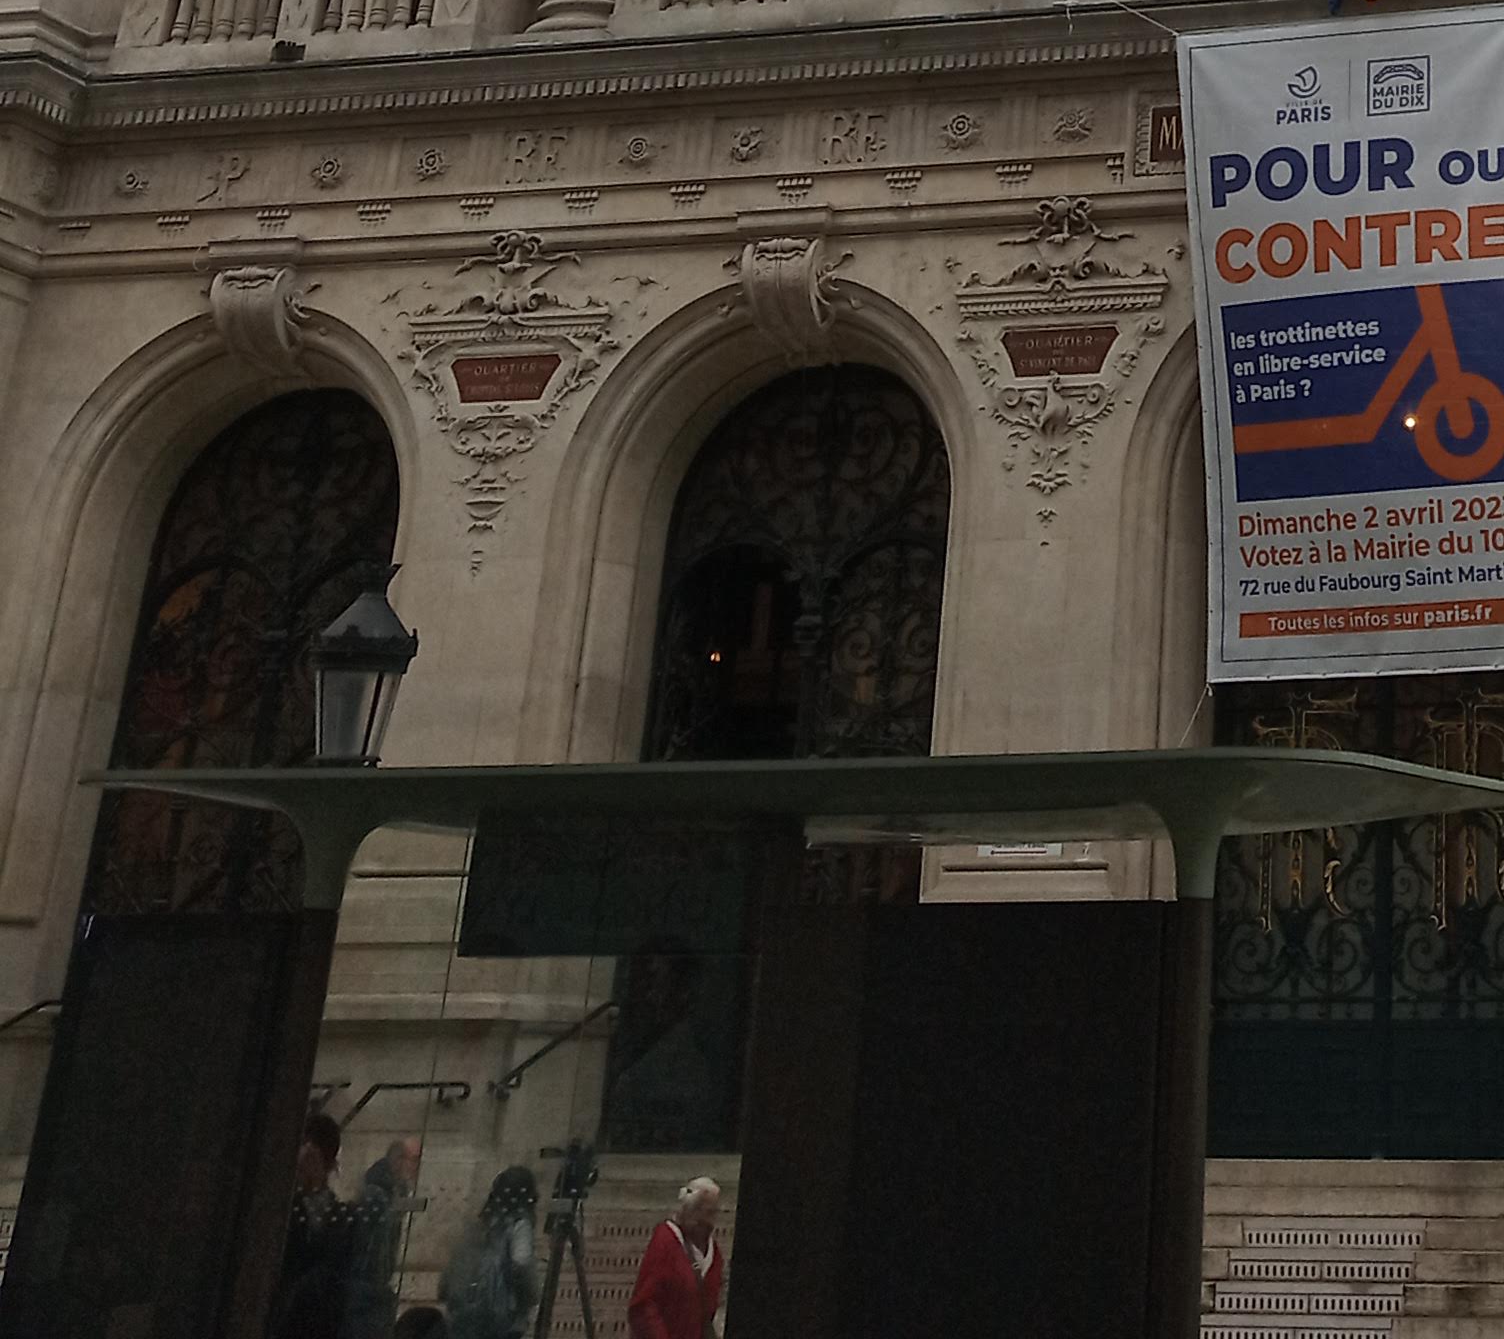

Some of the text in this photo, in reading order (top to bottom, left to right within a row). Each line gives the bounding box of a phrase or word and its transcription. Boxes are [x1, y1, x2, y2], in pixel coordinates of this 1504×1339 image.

[1372, 83, 1425, 98] MAIRIE
[1372, 95, 1425, 110] DU DIX
[1276, 106, 1332, 125] PARIS
[1209, 137, 1415, 209] POUR
[1230, 319, 1380, 351] les trottinettes
[1233, 344, 1386, 377] en libre-service
[1235, 378, 1311, 403] à Paris ?
[1239, 508, 1357, 538] Dimanche
[1364, 506, 1379, 530] 2
[1386, 499, 1443, 527] avril
[1239, 544, 1303, 569] Votez
[1309, 541, 1320, 565] à
[1327, 539, 1346, 562] la
[1354, 533, 1430, 562] Mairie
[1438, 530, 1473, 555] du
[1240, 579, 1260, 596] 72
[1264, 579, 1291, 595] rue
[1295, 574, 1315, 593] du
[1320, 572, 1401, 592] Faubourg
[1405, 567, 1454, 587] Saint
[1268, 605, 1492, 632] Toutes les infos sur paris.fr
